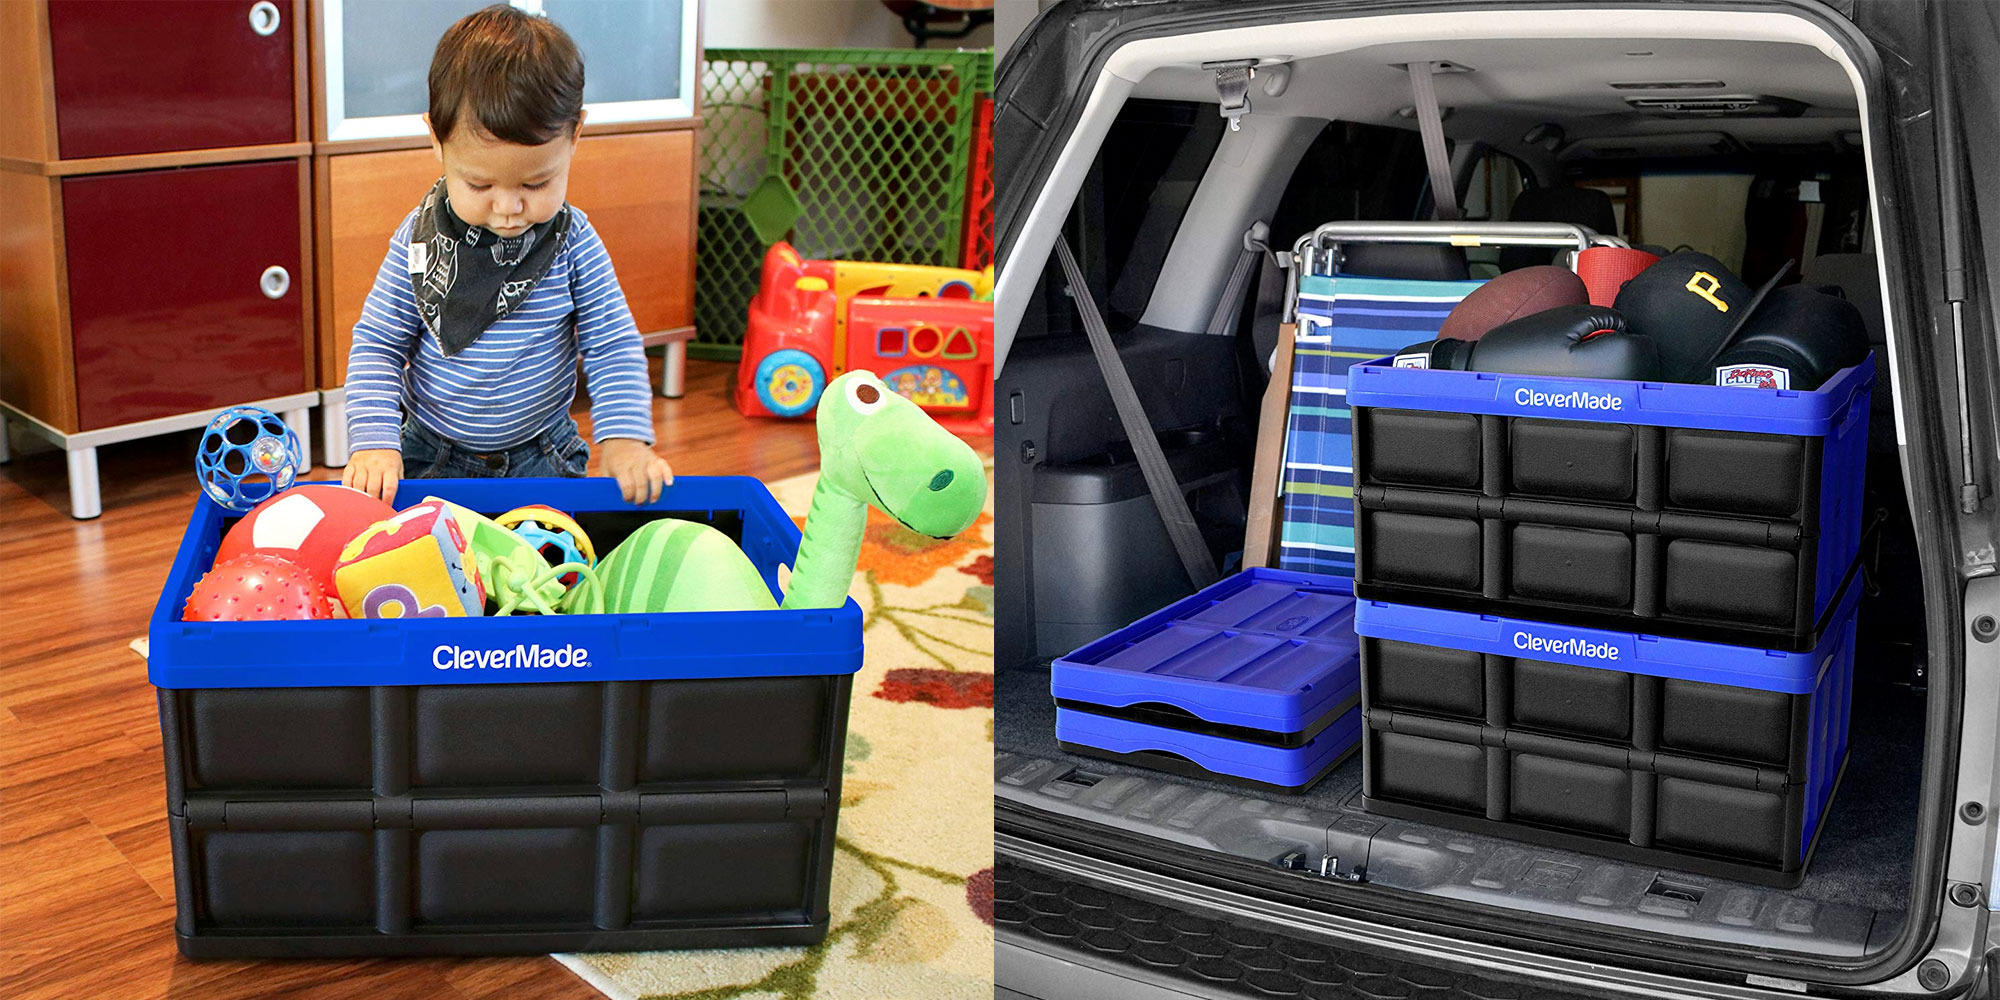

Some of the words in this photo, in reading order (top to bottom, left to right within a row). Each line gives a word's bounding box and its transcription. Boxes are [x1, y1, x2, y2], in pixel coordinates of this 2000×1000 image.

[1685, 271, 1729, 313] P
[1515, 388, 1622, 411] CleverMade
[432, 644, 588, 670] CleverMade
[1513, 632, 1619, 660] CleverMade
